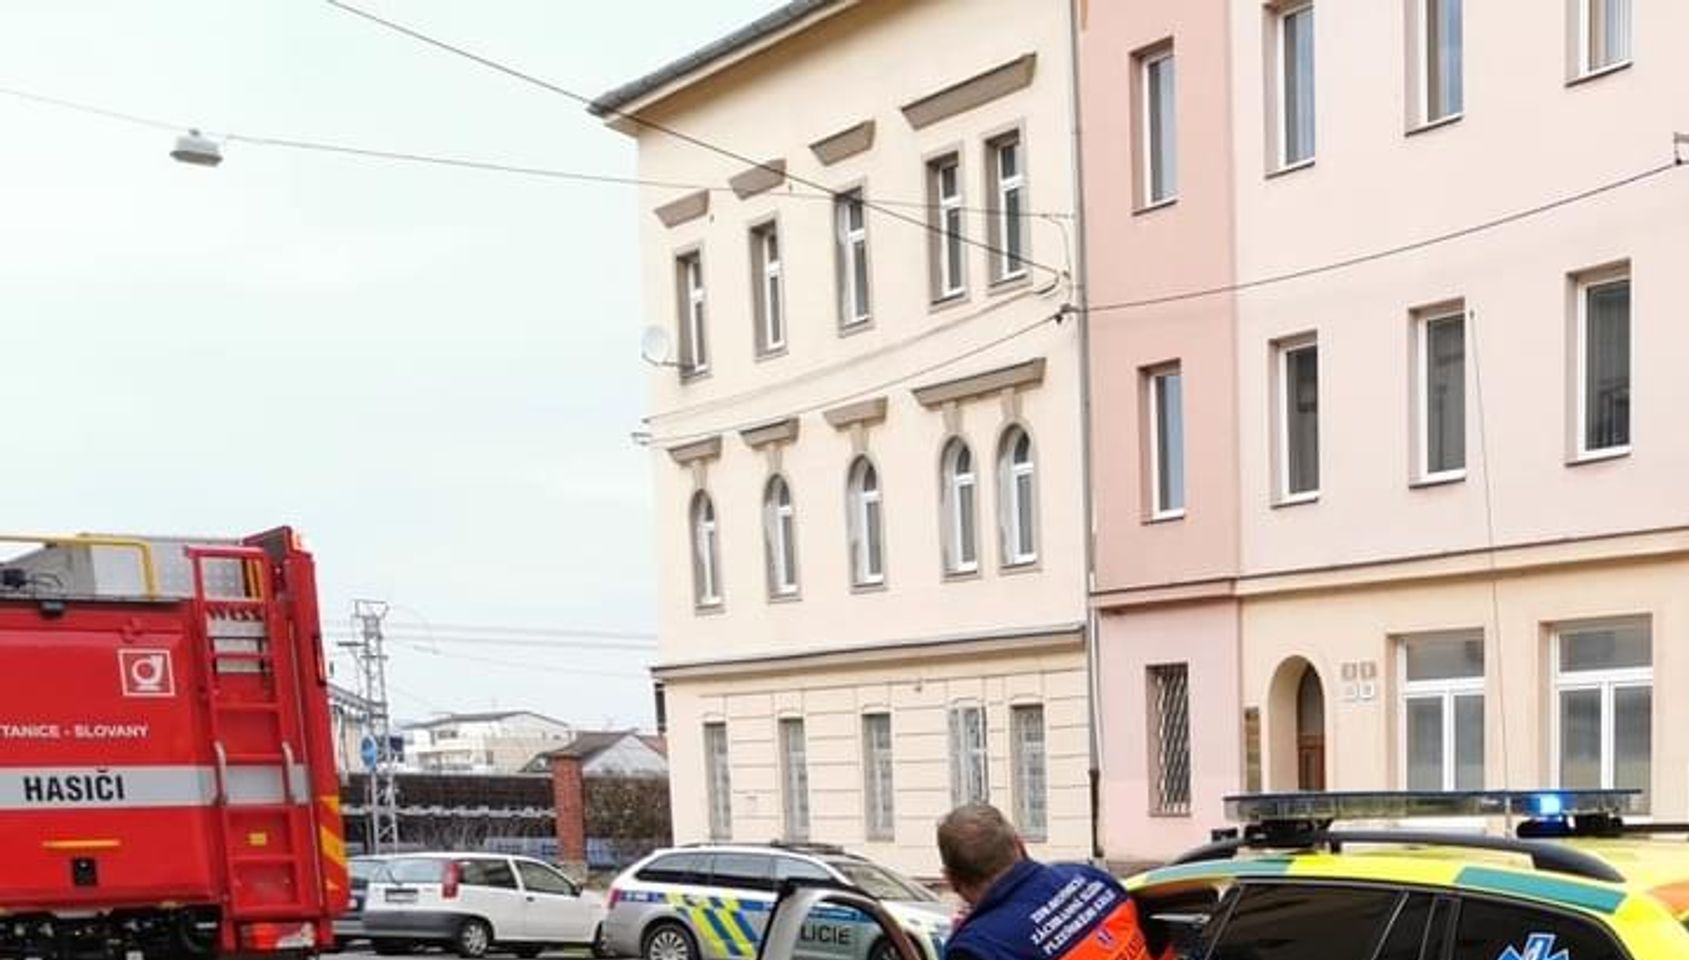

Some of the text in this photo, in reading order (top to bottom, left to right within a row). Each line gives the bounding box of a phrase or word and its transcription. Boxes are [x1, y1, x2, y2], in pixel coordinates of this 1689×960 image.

[0, 724, 60, 738] TANICE
[74, 723, 149, 738] SLOVANY
[23, 767, 126, 802] HASIČI
[800, 922, 852, 945] LICIE
